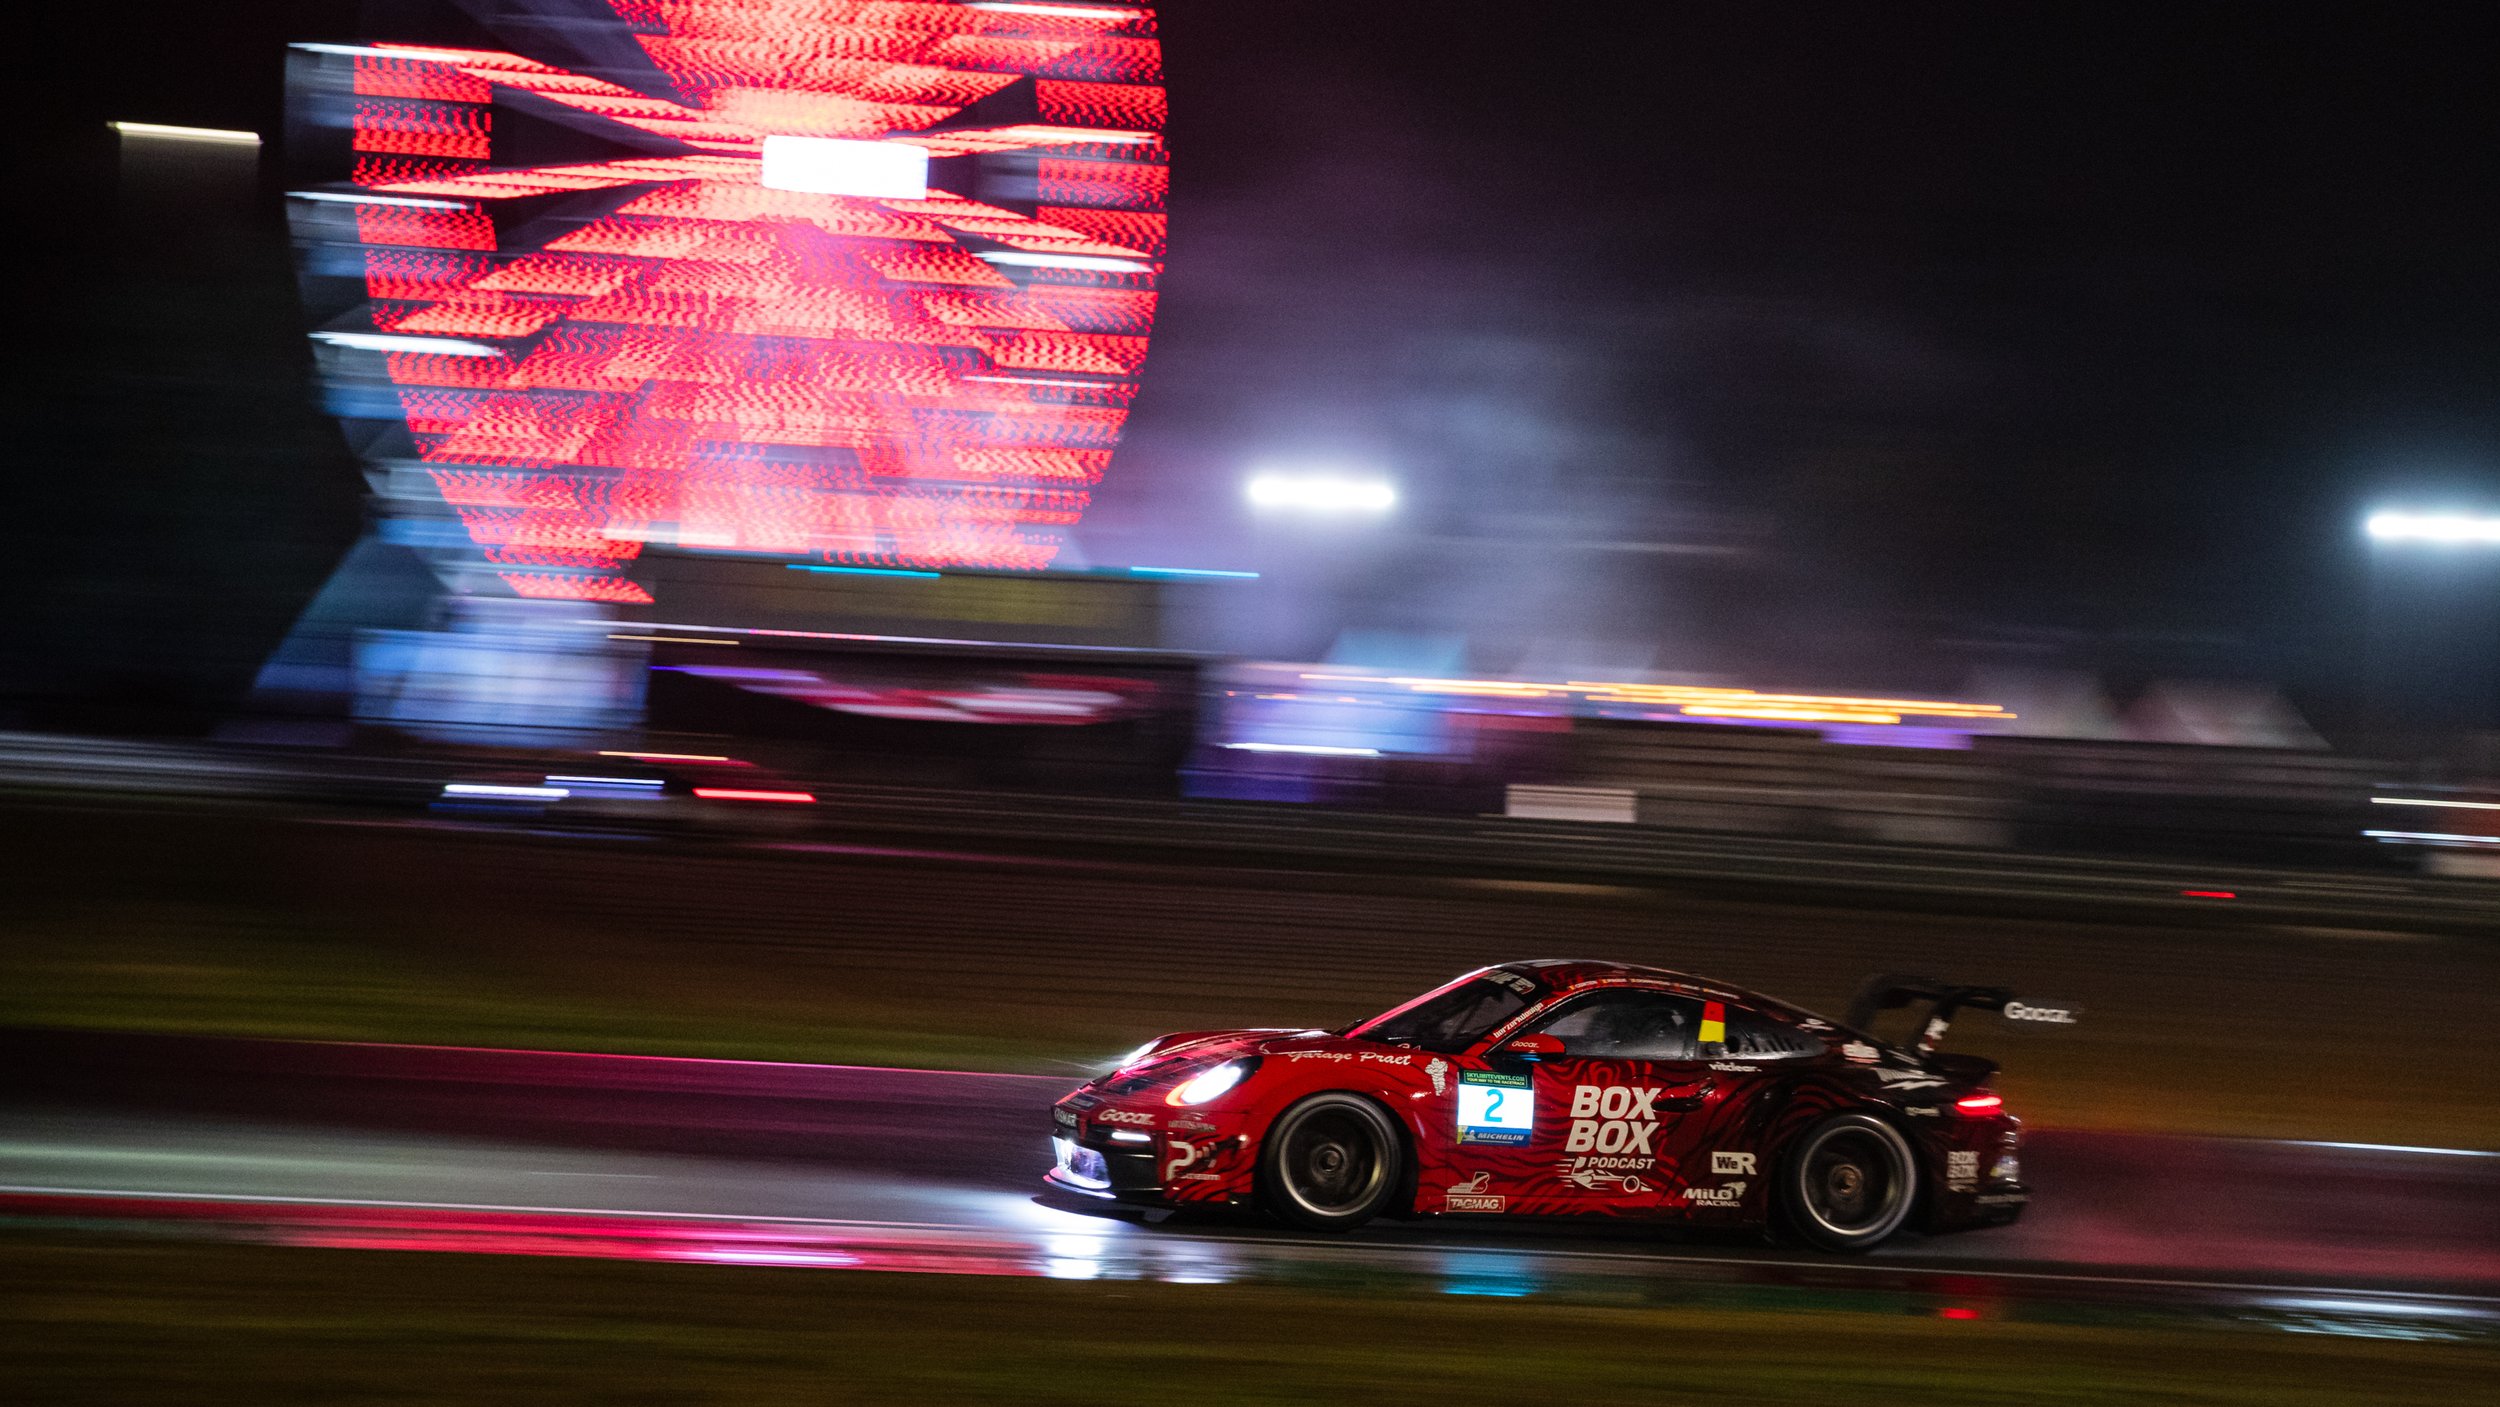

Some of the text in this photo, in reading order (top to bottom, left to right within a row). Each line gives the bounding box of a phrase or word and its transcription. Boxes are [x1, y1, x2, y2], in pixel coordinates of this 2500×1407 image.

[1483, 1088, 1504, 1123] 2
[1569, 1084, 1662, 1120] BOX
[1477, 1132, 1525, 1141] MICHELIN
[1564, 1119, 1661, 1155] BOX
[1587, 1157, 1656, 1170] PODCAST
[1695, 1199, 1742, 1208] RACING
